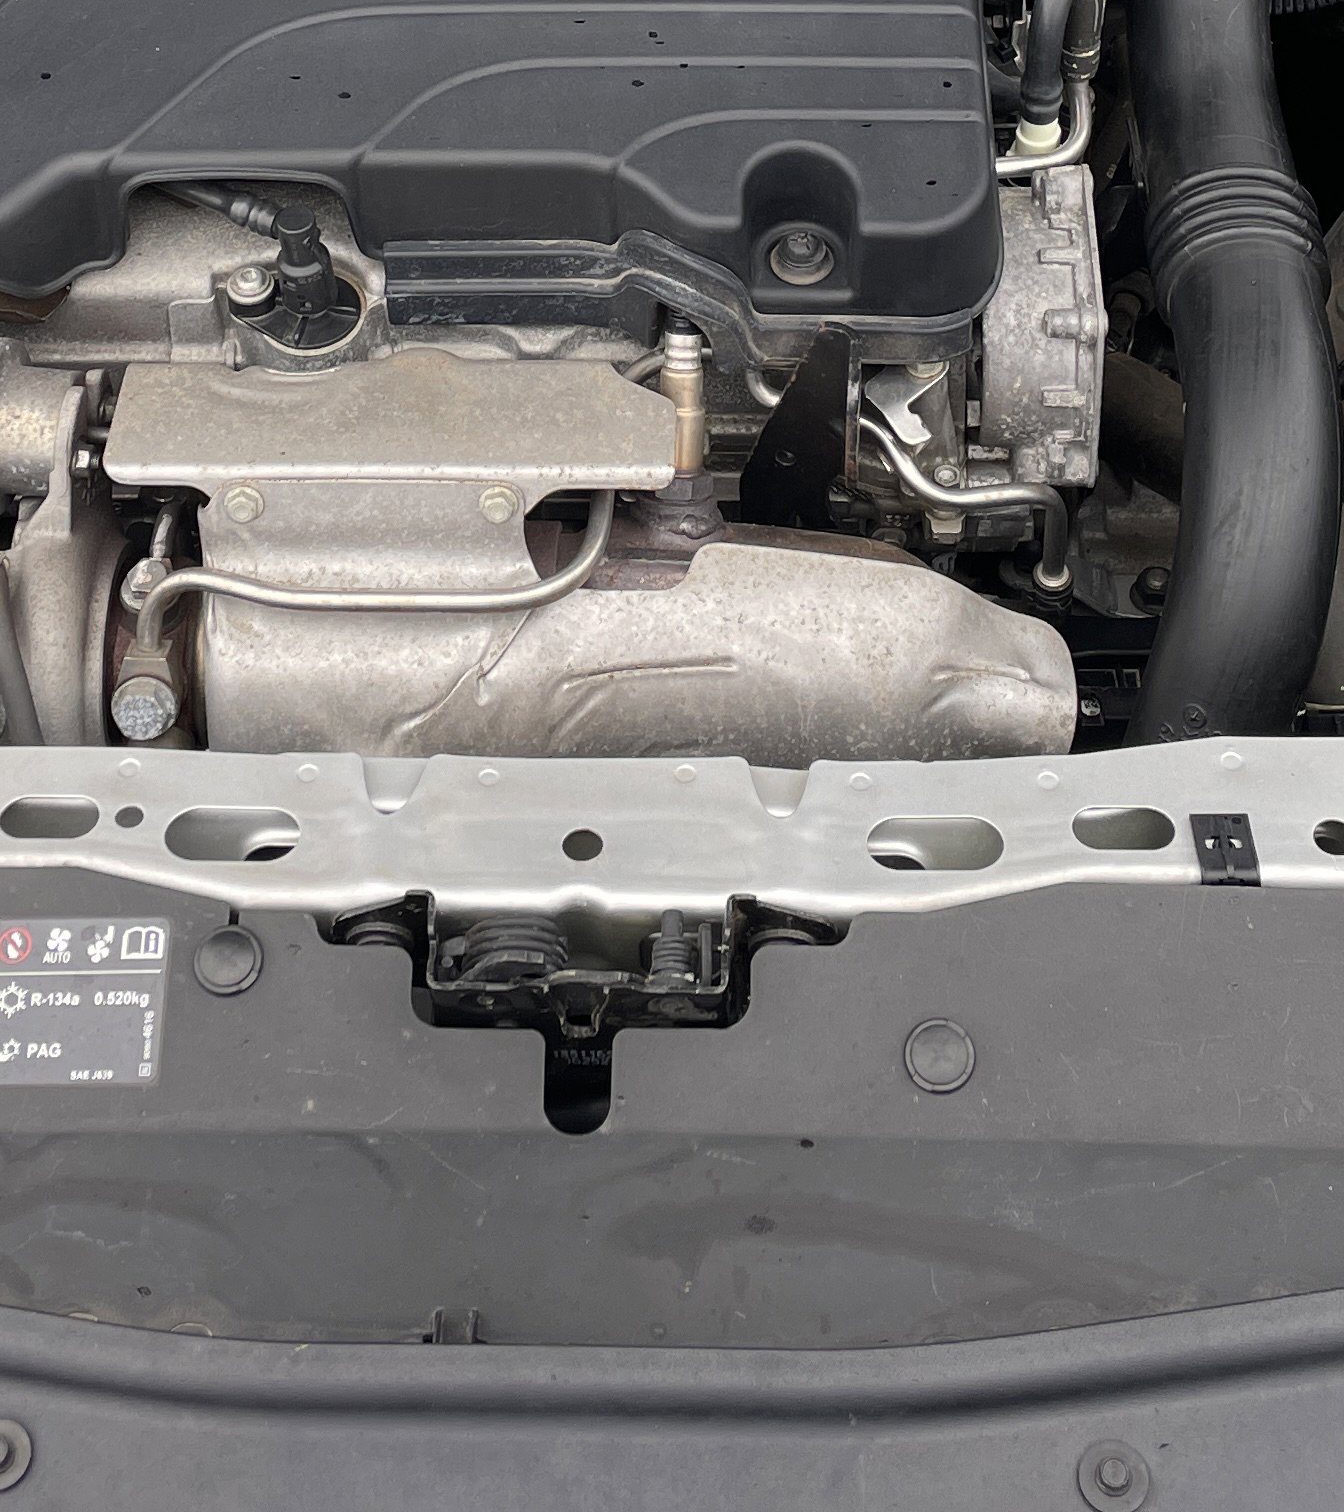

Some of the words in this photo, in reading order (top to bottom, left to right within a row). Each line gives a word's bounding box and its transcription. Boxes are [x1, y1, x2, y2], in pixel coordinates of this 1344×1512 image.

[42, 951, 71, 964] AUTO
[30, 992, 80, 1007] R-134a
[93, 991, 150, 1008] 0.520kg
[27, 1043, 62, 1058] PAG
